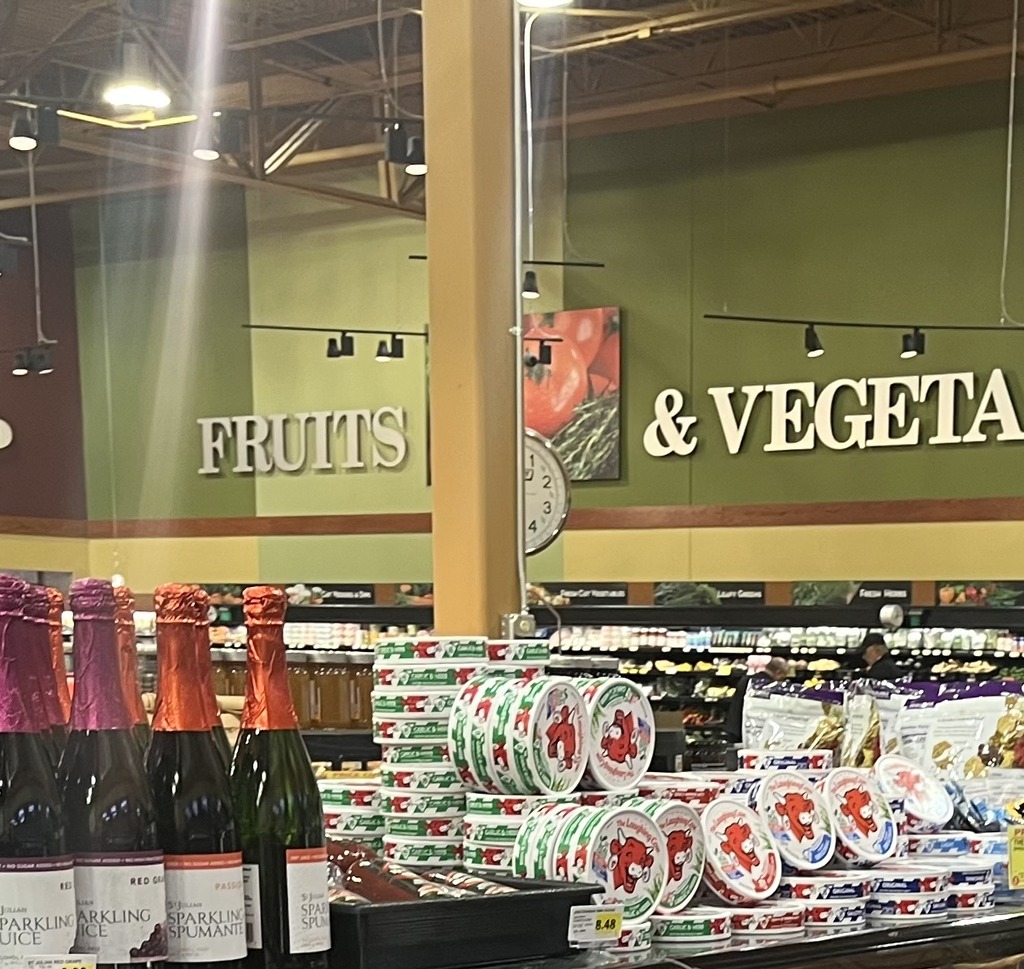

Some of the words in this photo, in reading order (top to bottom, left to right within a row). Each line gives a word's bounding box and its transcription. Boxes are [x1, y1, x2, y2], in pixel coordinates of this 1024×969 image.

[643, 388, 698, 457] &
[198, 406, 408, 476] FRUITS
[529, 454, 535, 467] 1
[542, 475, 552, 489] 2
[543, 500, 552, 514] 3
[528, 520, 537, 533] 4
[130, 876, 150, 886] RED
[215, 880, 242, 891] PASSIO
[0, 913, 74, 932] PARKLING
[77, 908, 151, 925] ARKLING
[80, 923, 109, 938] ICE
[168, 922, 244, 938] SPUMANTE
[595, 918, 616, 931] 8.48
[0, 931, 42, 946] UICE
